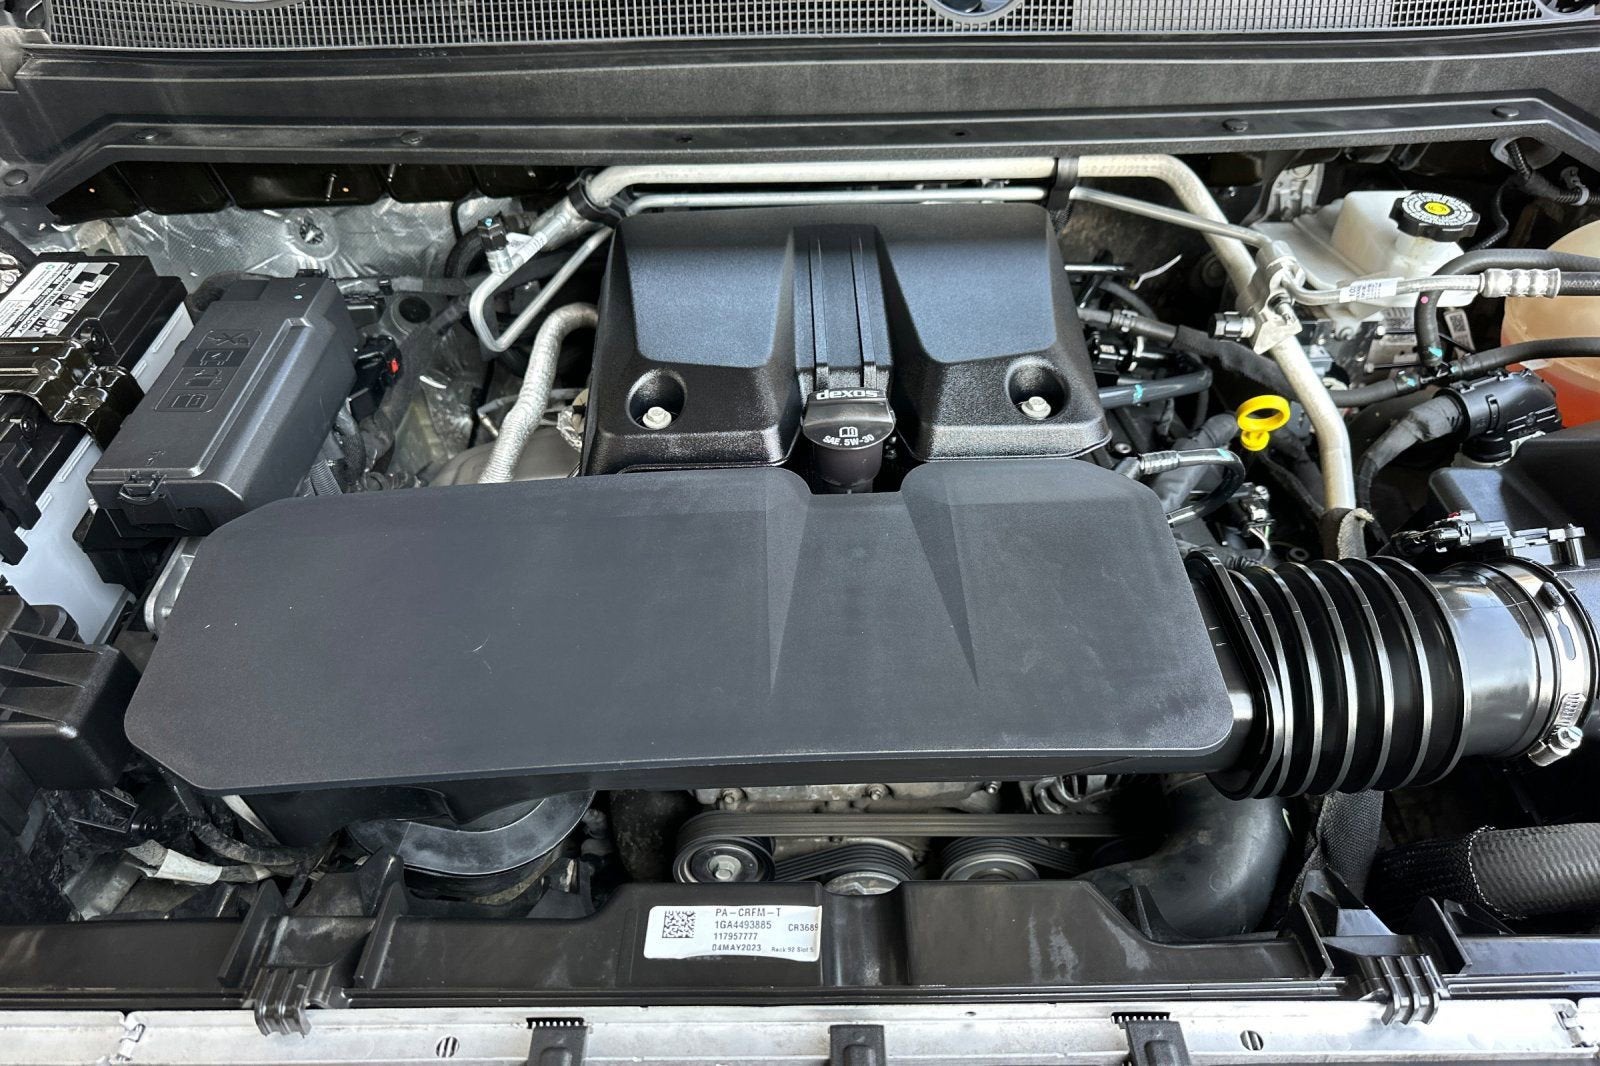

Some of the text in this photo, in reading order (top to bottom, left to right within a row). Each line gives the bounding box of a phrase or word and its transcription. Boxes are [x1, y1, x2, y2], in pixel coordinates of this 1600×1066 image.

[40, 279, 102, 335] Duralast
[32, 294, 70, 332] PLAUM
[816, 389, 879, 400] dexos
[843, 434, 875, 446] 5W-30
[713, 932, 758, 941] 117957777
[711, 943, 762, 952] 04MAY2023
